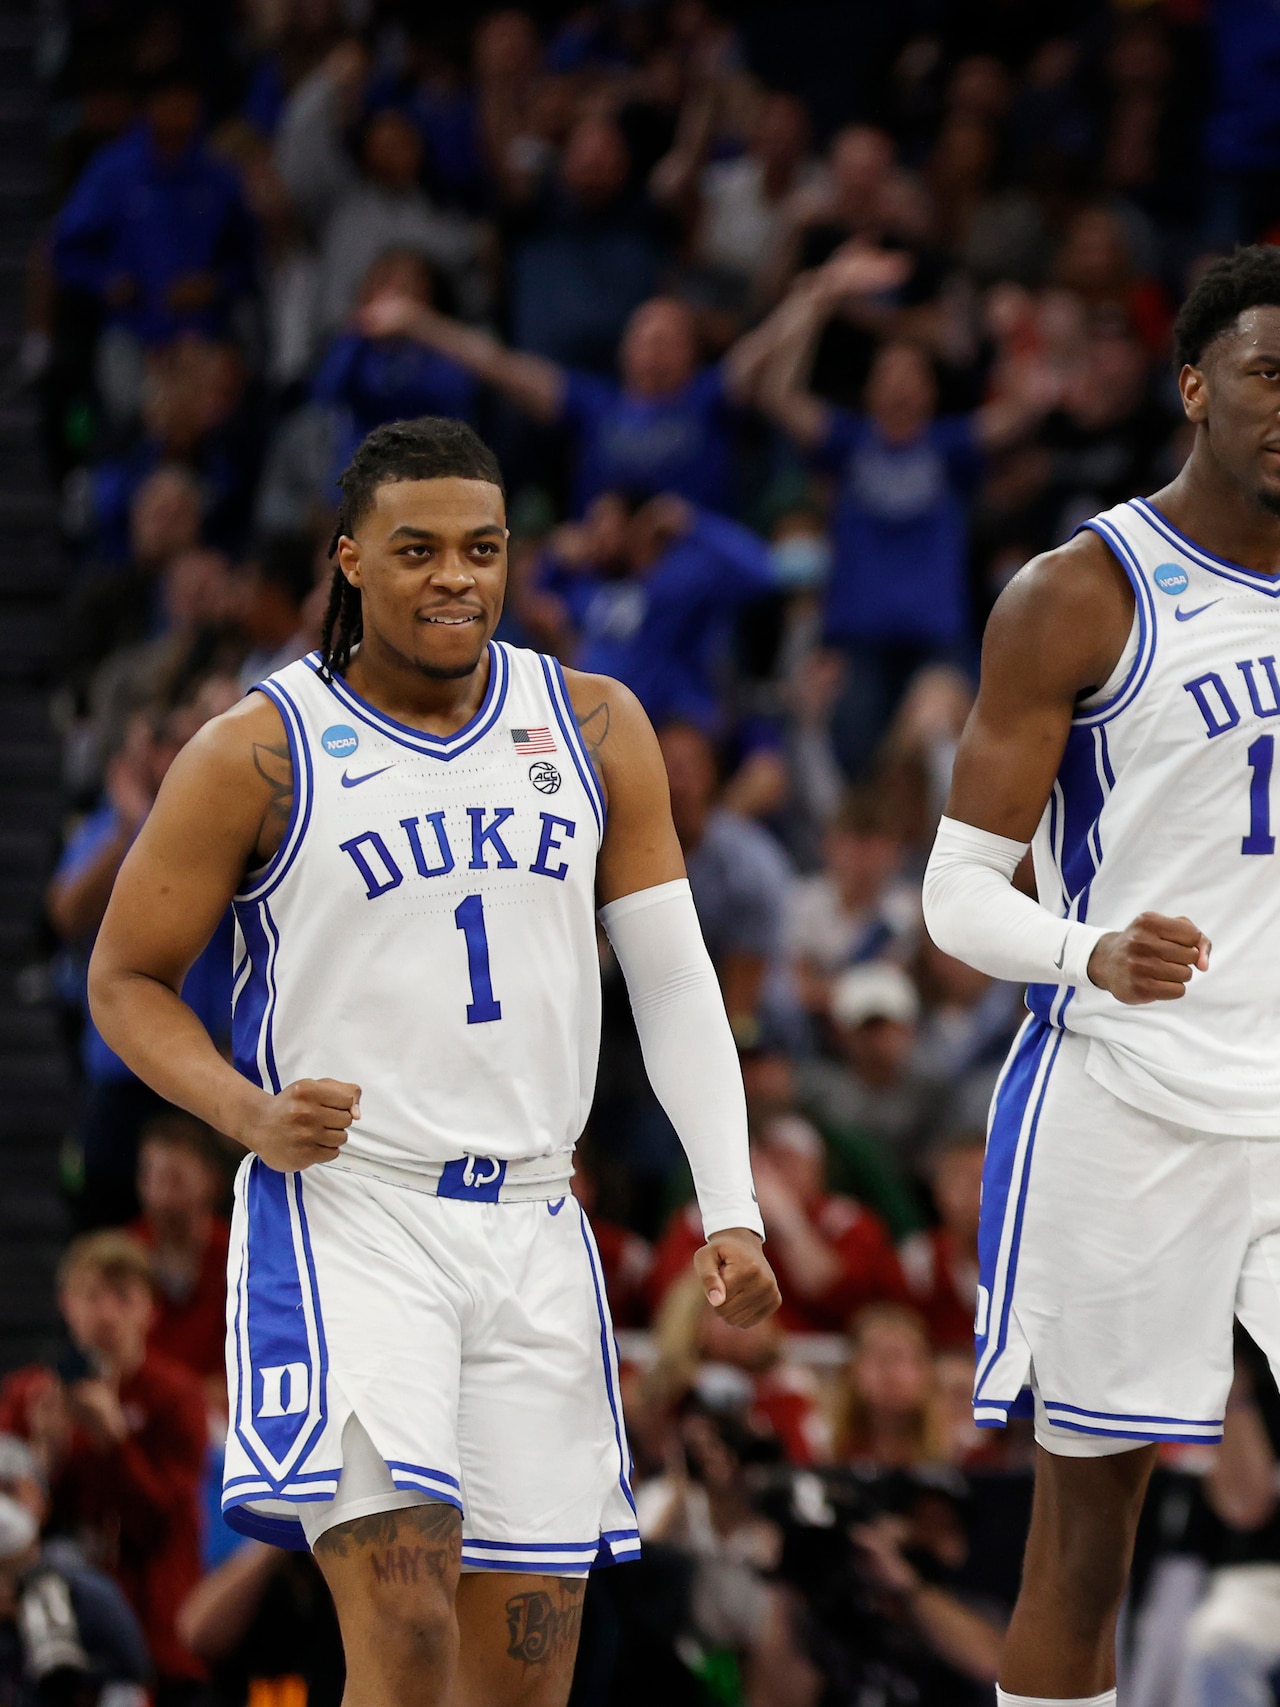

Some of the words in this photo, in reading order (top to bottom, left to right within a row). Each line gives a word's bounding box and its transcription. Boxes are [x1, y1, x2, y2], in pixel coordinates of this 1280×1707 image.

[1159, 575, 1187, 588] NCAA
[326, 737, 357, 750] NCAA
[338, 807, 577, 900] DUKE
[454, 893, 503, 1025] 1
[257, 1361, 311, 1418] D
